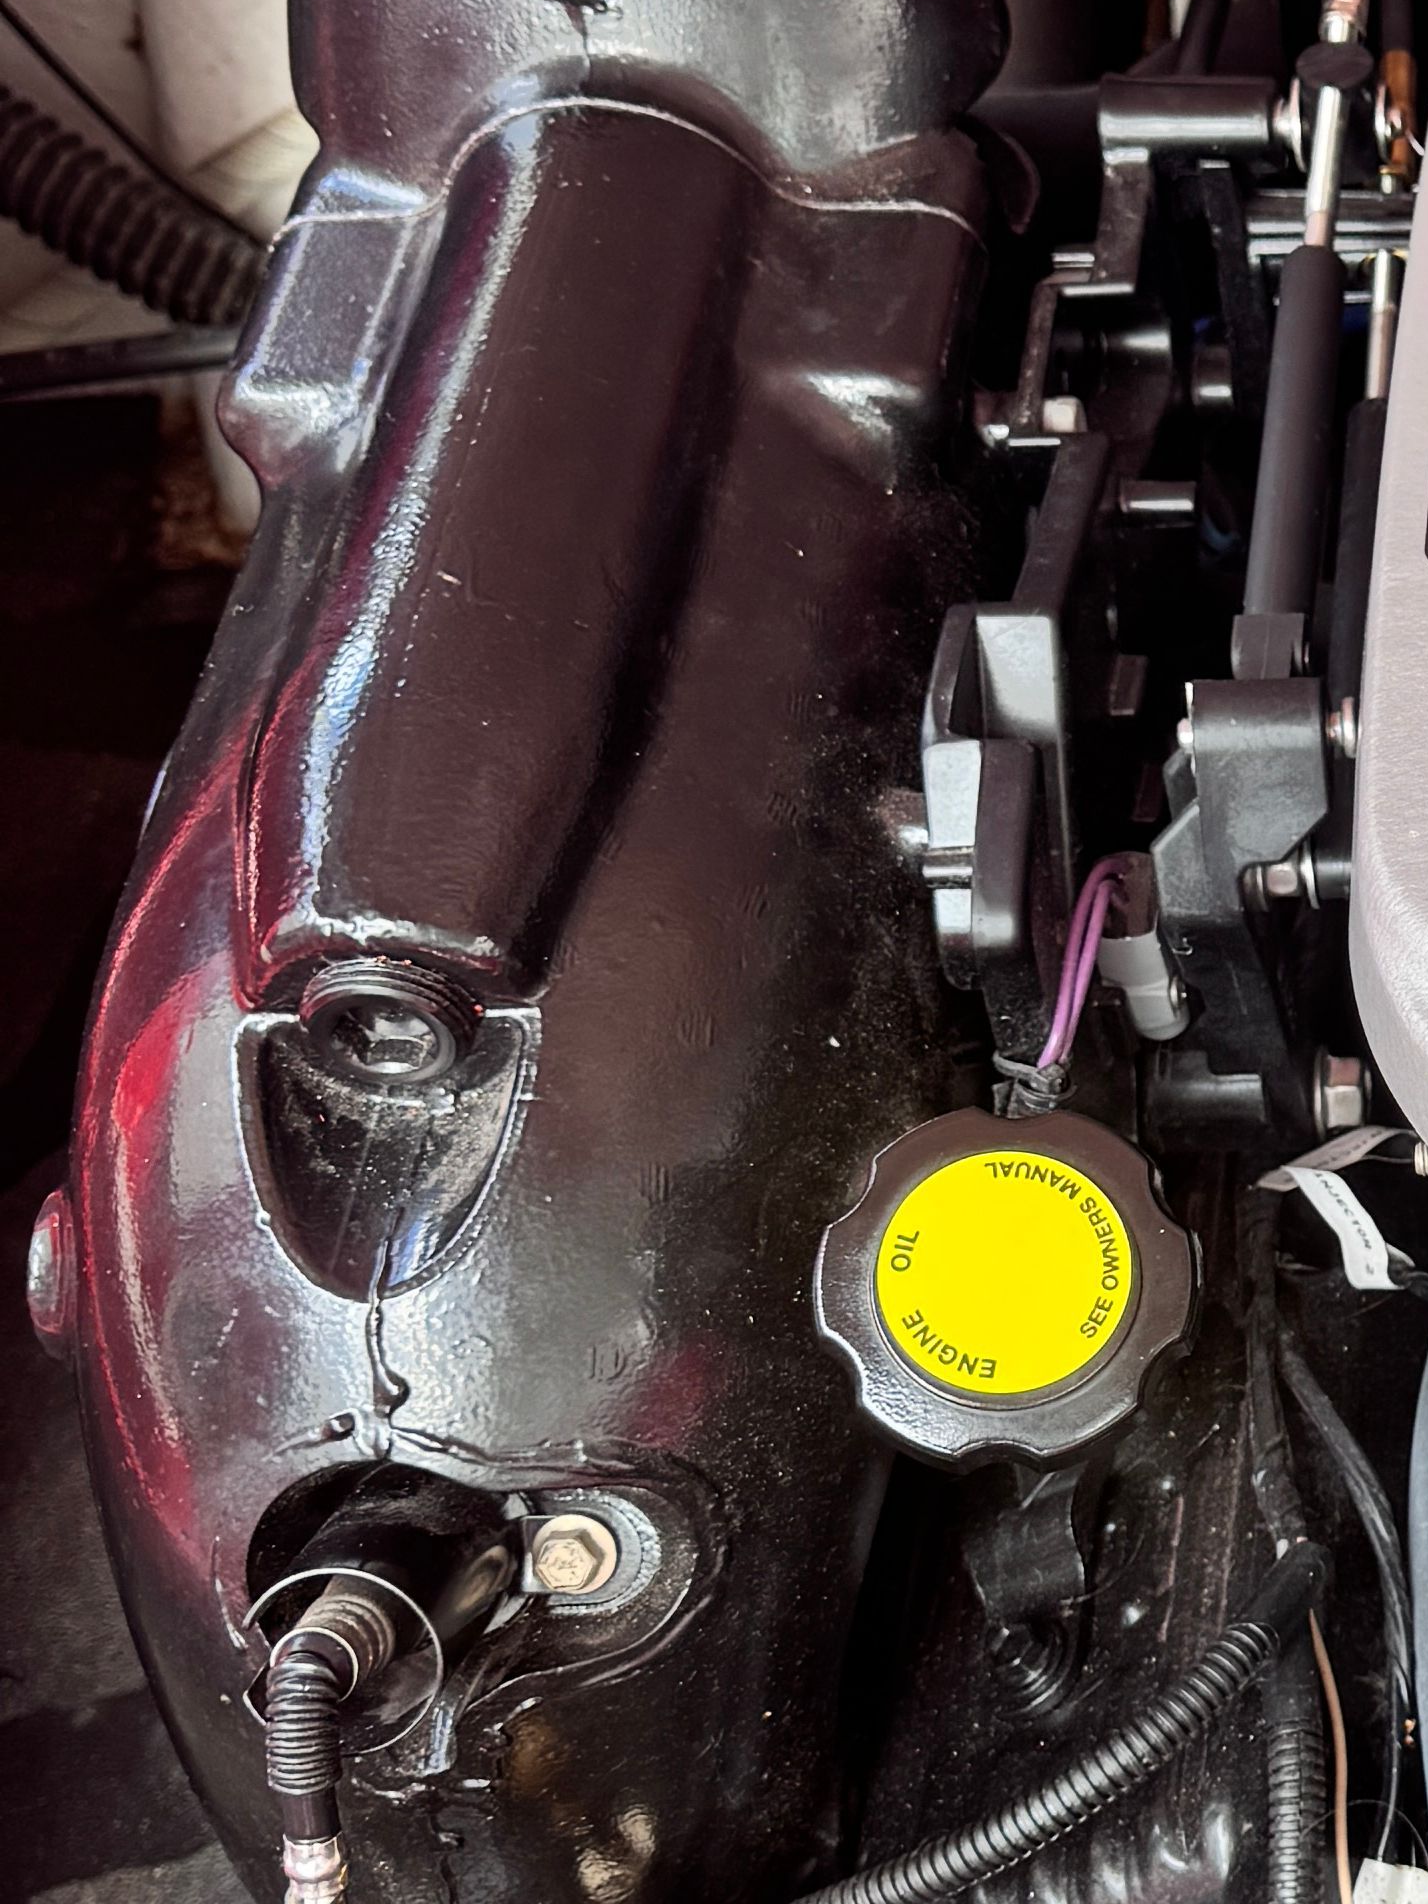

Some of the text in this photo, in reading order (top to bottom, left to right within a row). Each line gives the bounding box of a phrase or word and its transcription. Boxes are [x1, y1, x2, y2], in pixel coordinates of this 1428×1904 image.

[985, 1161, 1120, 1339] SEE OWNERS MANUAL
[1315, 1173, 1373, 1250] INJECTOR
[890, 1229, 997, 1379] ENGINE OIL
